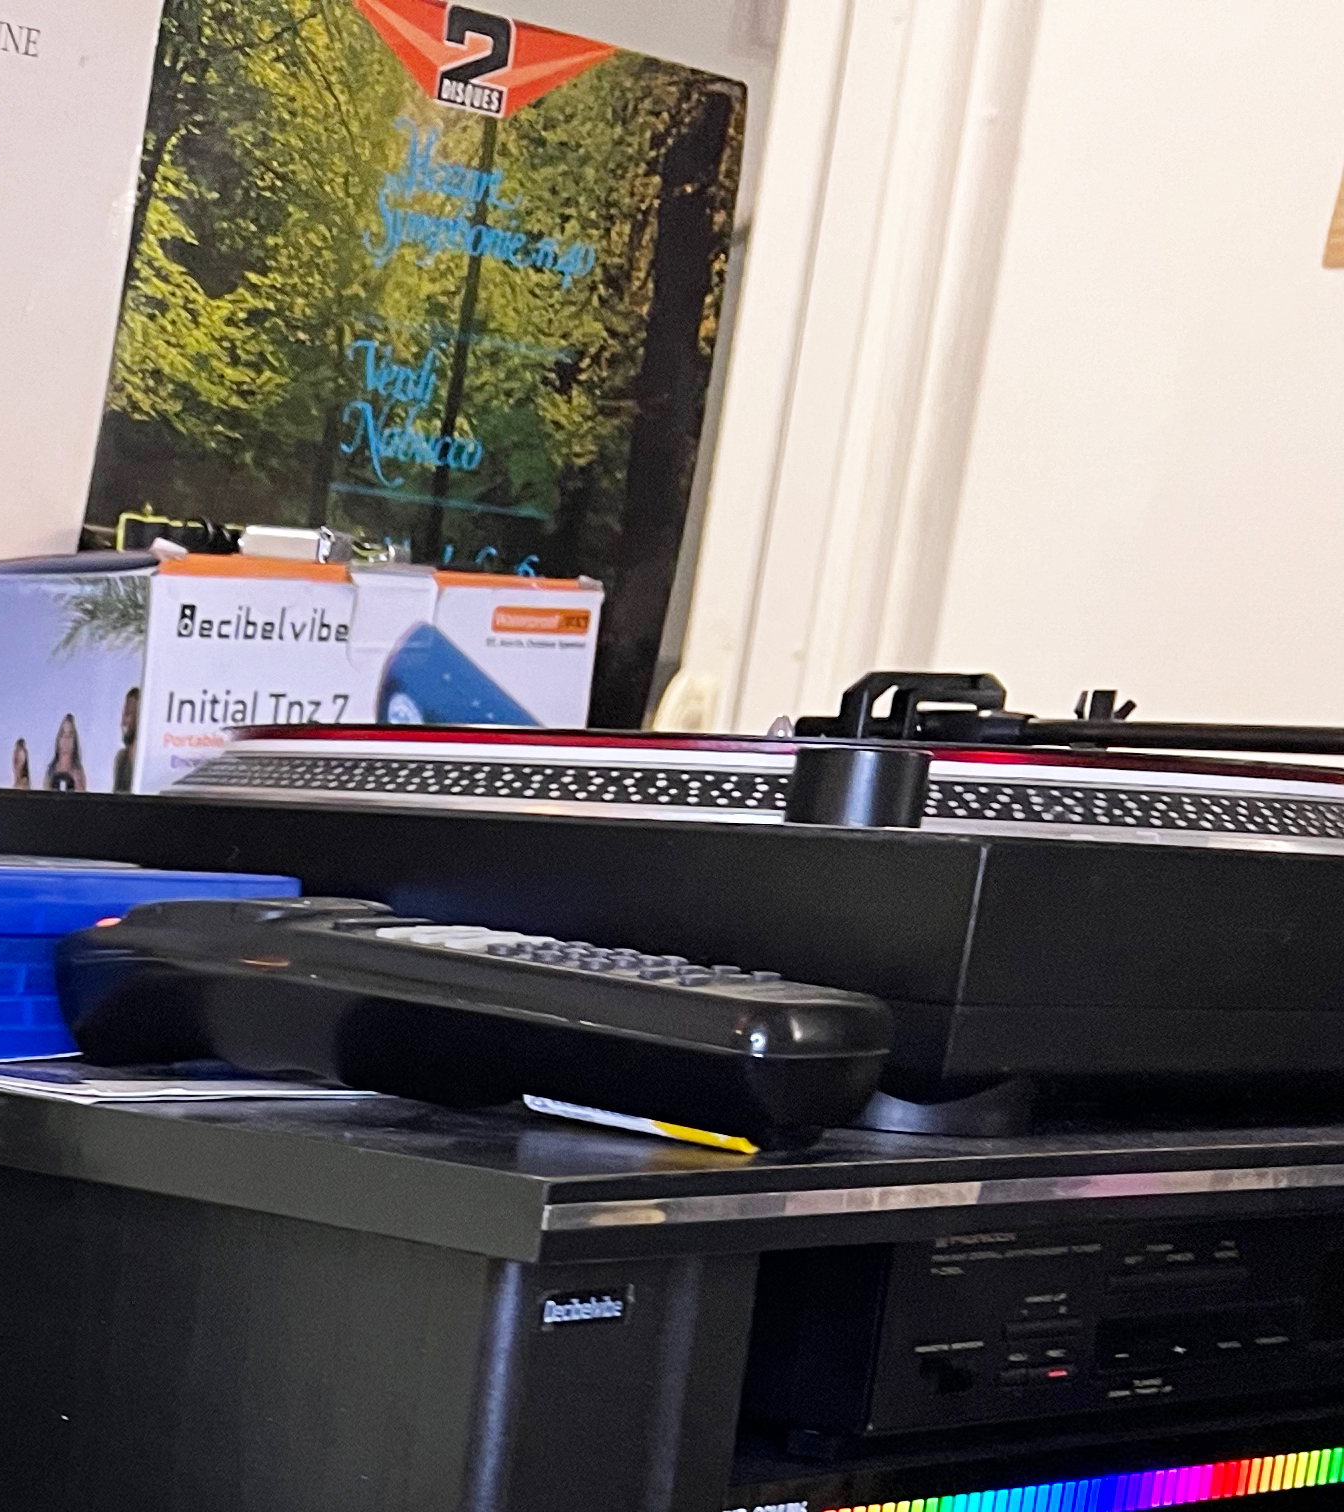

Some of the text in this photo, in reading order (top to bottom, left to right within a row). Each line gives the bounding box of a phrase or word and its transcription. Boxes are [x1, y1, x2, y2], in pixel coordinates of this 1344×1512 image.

[442, 5, 512, 82] 2
[441, 77, 501, 112] DISQUES
[340, 400, 484, 488] Nabucco
[166, 689, 350, 725] Initial Tnz 7
